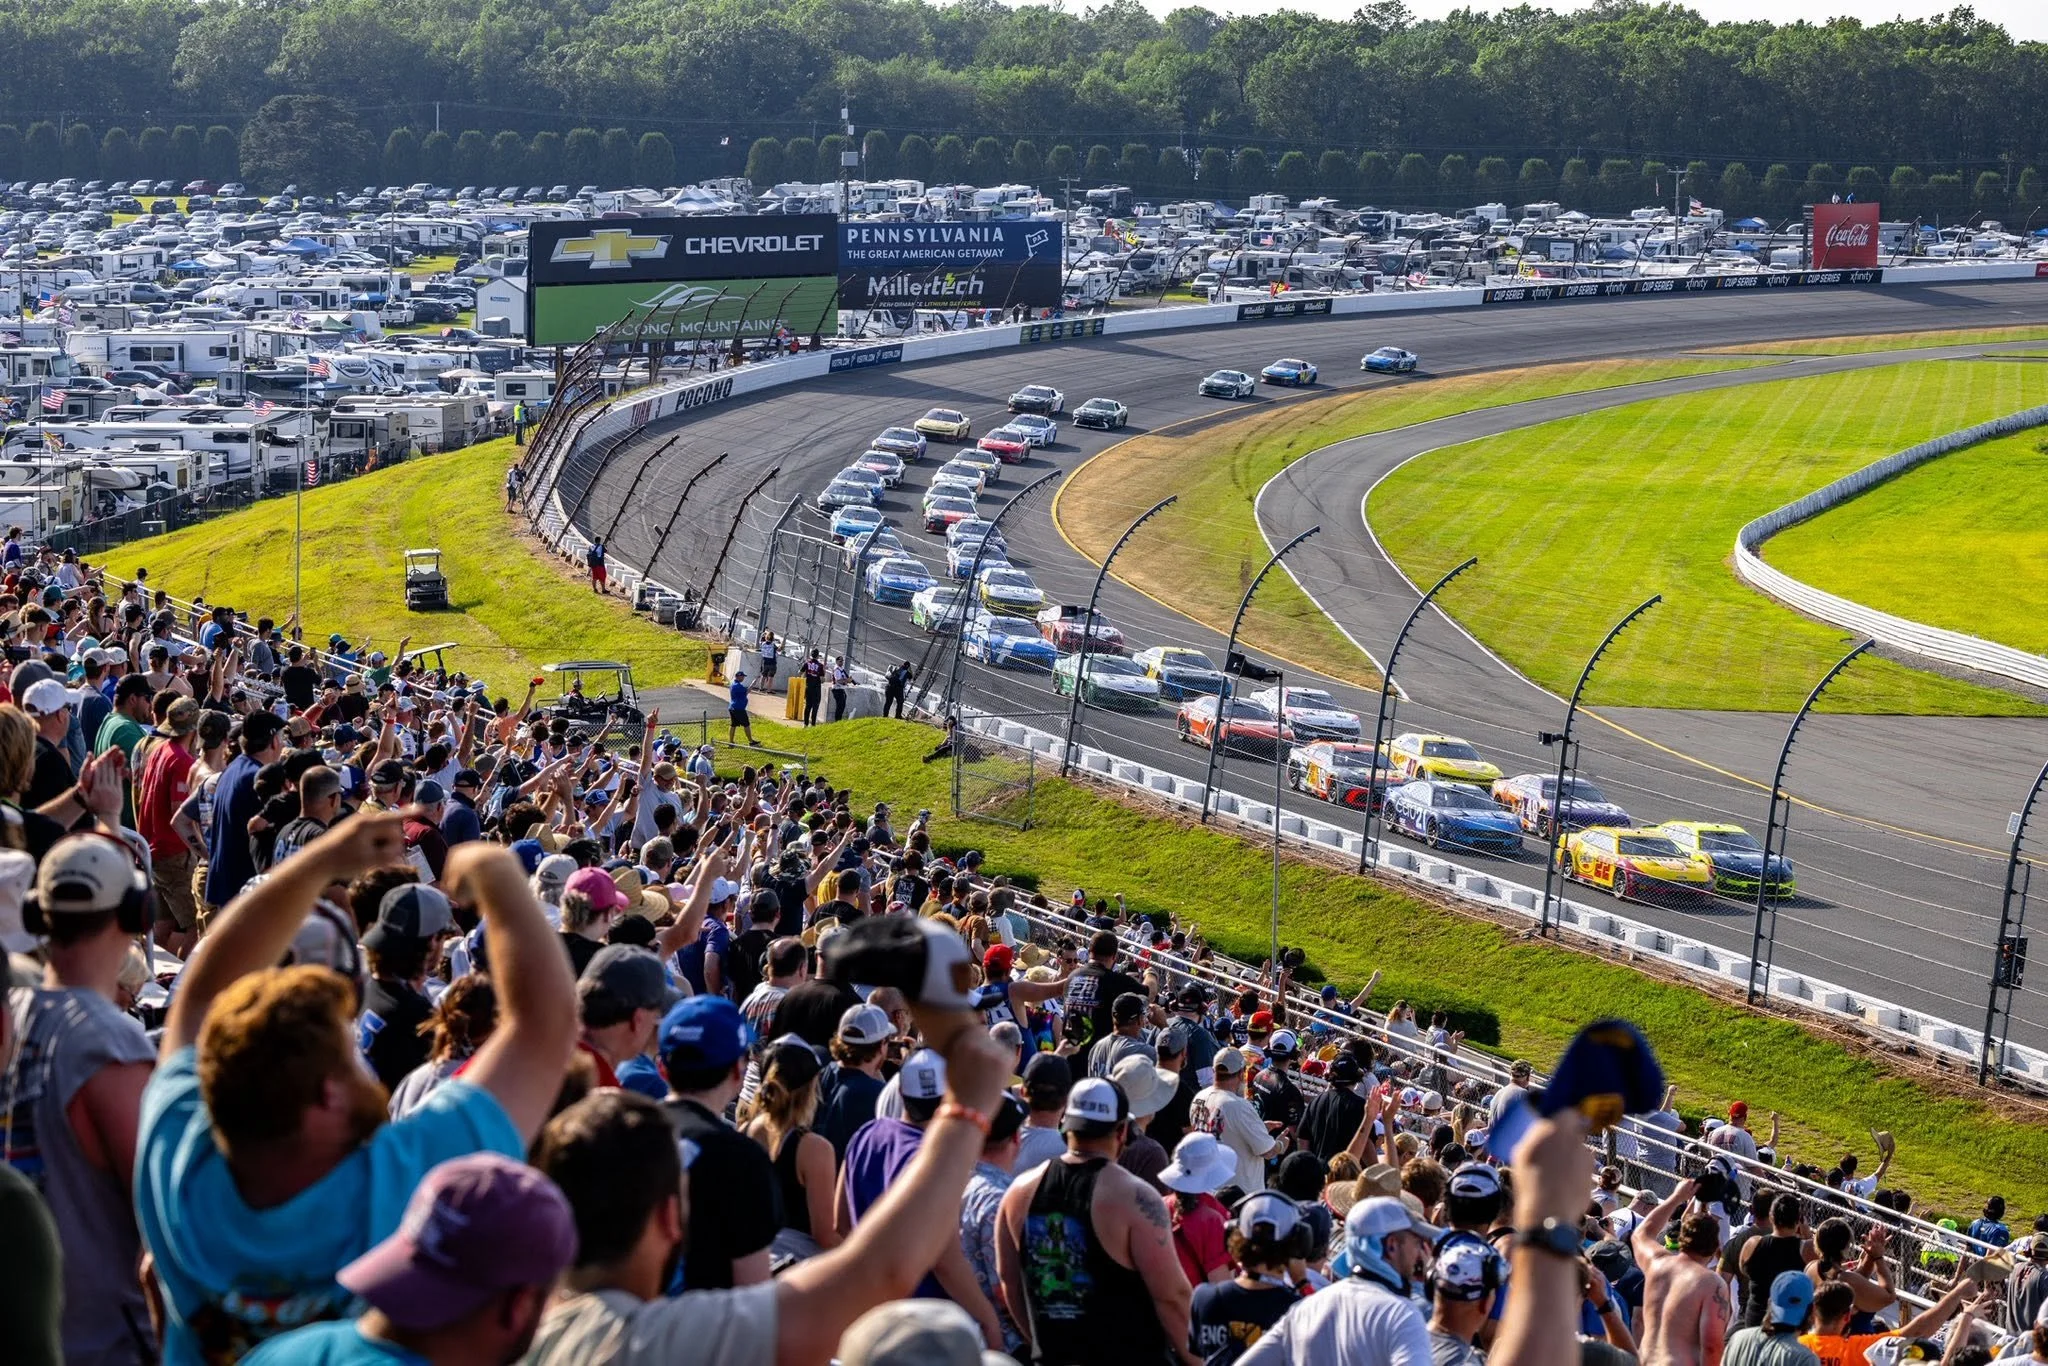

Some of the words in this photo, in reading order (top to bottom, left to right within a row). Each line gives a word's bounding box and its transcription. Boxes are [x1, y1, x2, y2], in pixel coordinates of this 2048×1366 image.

[847, 227, 1004, 244] PENNSYLVANIA
[685, 234, 824, 255] CHEVROLET
[848, 249, 866, 259] THE
[868, 249, 900, 259] GREAT
[902, 249, 956, 259] AMERICAN
[958, 248, 1004, 258] GETAWAY
[1685, 277, 1708, 291] xfinity
[1724, 278, 1736, 288] CUP
[1737, 276, 1758, 287] SERIES
[1766, 274, 1791, 287] xfinity
[1807, 274, 1819, 284] CUP
[1820, 273, 1841, 283] SERIES
[1851, 271, 1873, 284] xfinity
[867, 273, 984, 297] Millertech
[1566, 287, 1578, 296] CUP
[1579, 284, 1598, 295] SERIES
[1605, 281, 1627, 295] xfinity
[1641, 282, 1654, 291] CUP
[1655, 280, 1675, 290] SERIES
[1493, 291, 1505, 301] CUP
[1506, 289, 1525, 300] SERIES
[1532, 287, 1553, 301] xfinity
[680, 319, 783, 334] MOUNTAINS
[675, 377, 734, 412] POCONO
[1594, 861, 1611, 881] 22
